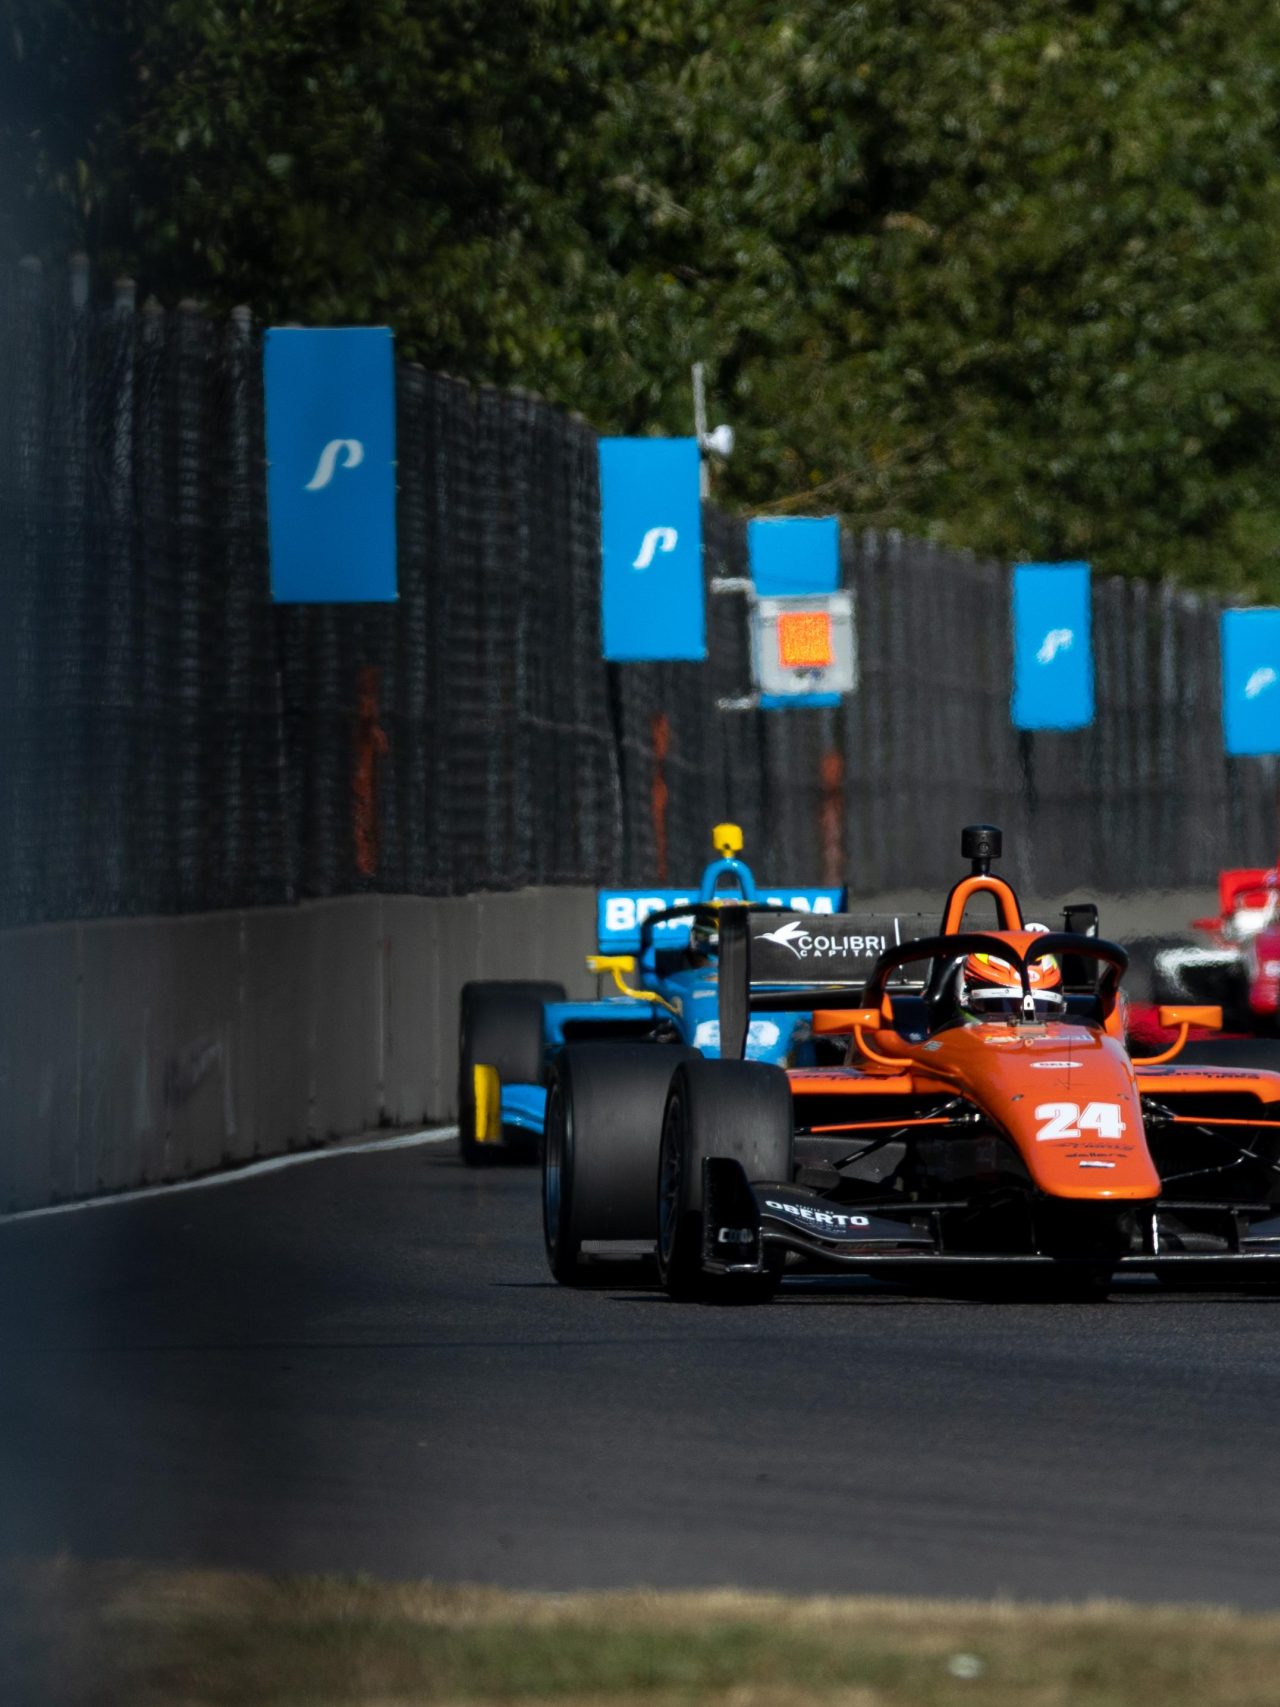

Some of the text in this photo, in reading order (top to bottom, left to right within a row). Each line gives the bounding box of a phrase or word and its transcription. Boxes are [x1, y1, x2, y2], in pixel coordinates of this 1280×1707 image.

[798, 935, 886, 951] COLIBRI
[1035, 1102, 1127, 1141] 24
[765, 1200, 870, 1226] OBERTO
